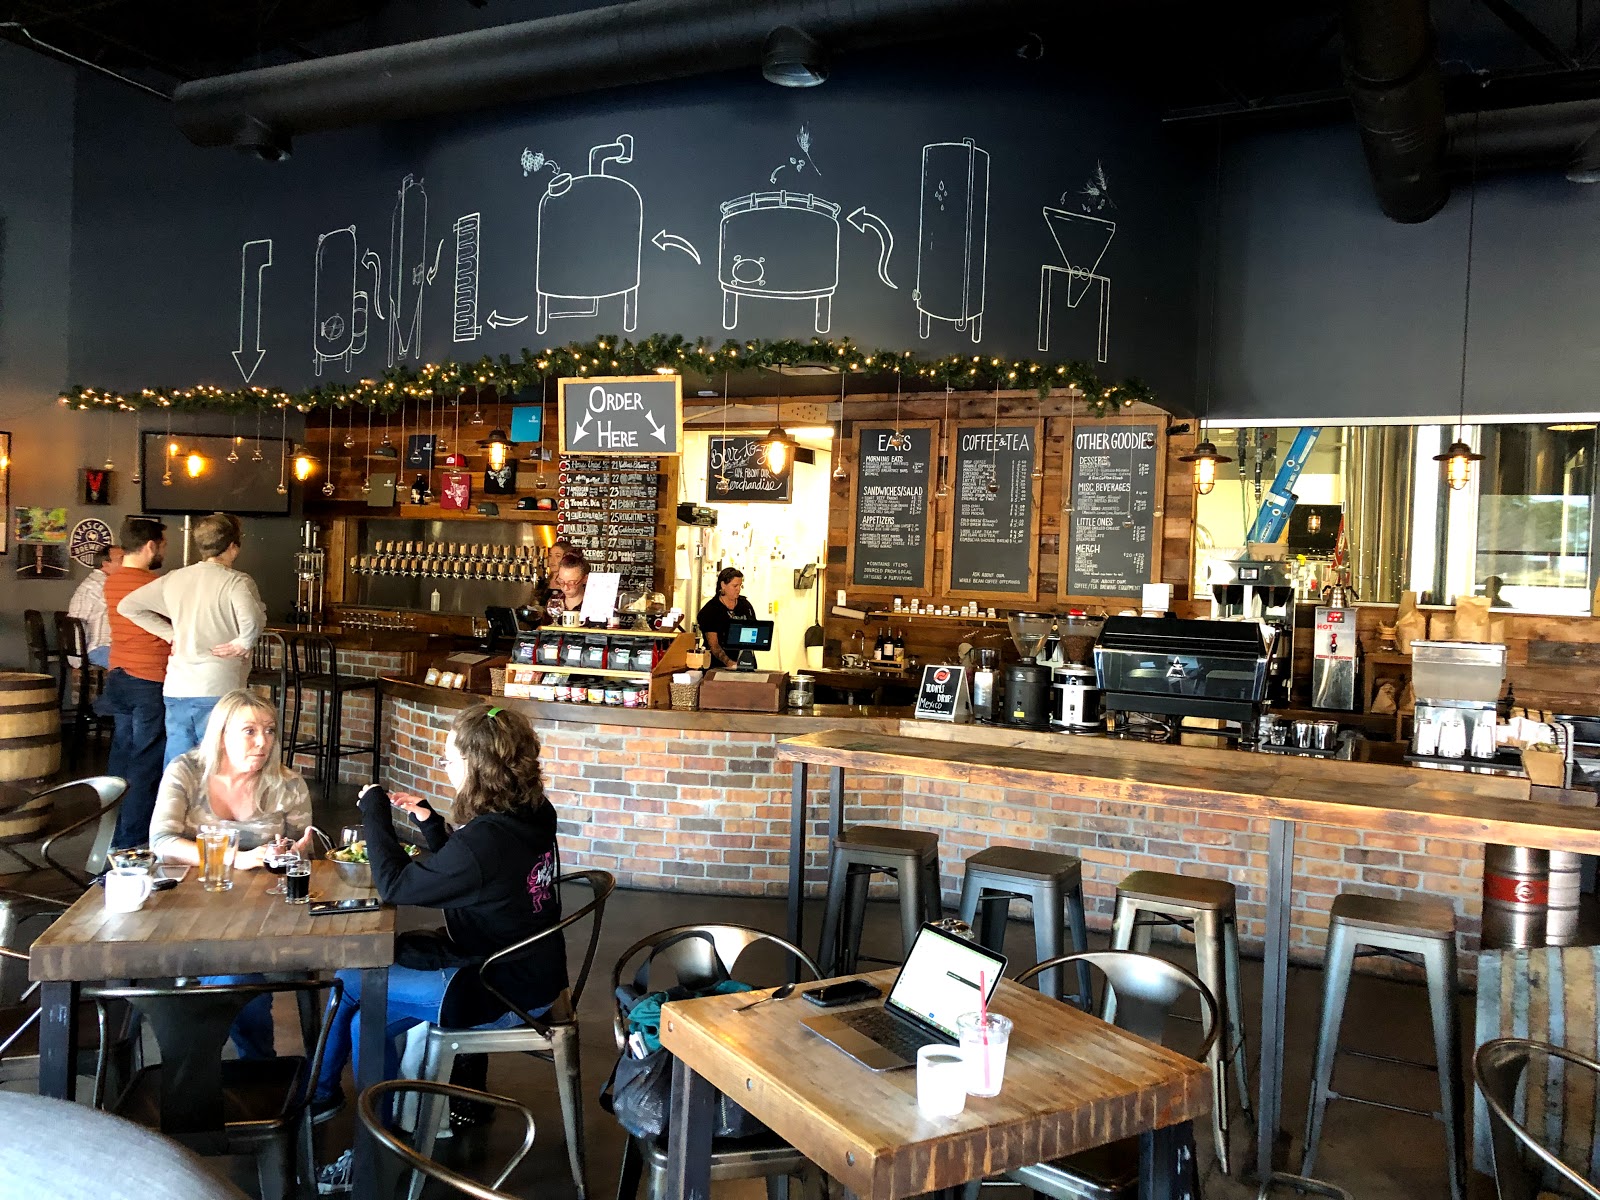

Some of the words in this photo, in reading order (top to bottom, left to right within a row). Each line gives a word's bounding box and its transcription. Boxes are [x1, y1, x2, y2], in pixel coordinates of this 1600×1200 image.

[589, 385, 644, 413] ORDER
[597, 420, 639, 449] HERE
[962, 433, 1002, 451] COFFEE
[1006, 433, 1030, 451] TEA
[1076, 433, 1110, 450] OTHER
[1111, 432, 1154, 450] GOODIES
[611, 461, 619, 470] 21
[566, 473, 572, 483] 6
[611, 474, 619, 483] 22
[718, 478, 782, 491] erchandise
[1095, 482, 1131, 492] BEVERAGES
[566, 486, 570, 496] 7
[609, 486, 619, 497] 23
[863, 486, 923, 496] SANDWICHES/SALAD
[564, 498, 570, 510] 8
[565, 512, 571, 521] 9
[610, 512, 619, 523] 25
[862, 515, 895, 525] APPETIZERS
[1076, 517, 1096, 526] LITTLE
[1097, 517, 1114, 526] ONES
[73, 522, 92, 544] TEXAS
[93, 522, 111, 544] CRAFT
[609, 524, 618, 536] 26
[608, 538, 617, 548] 27
[1075, 544, 1101, 553] MERCH
[607, 551, 618, 562] 28
[919, 697, 943, 709] Mexico
[937, 693, 954, 703] DRIP:
